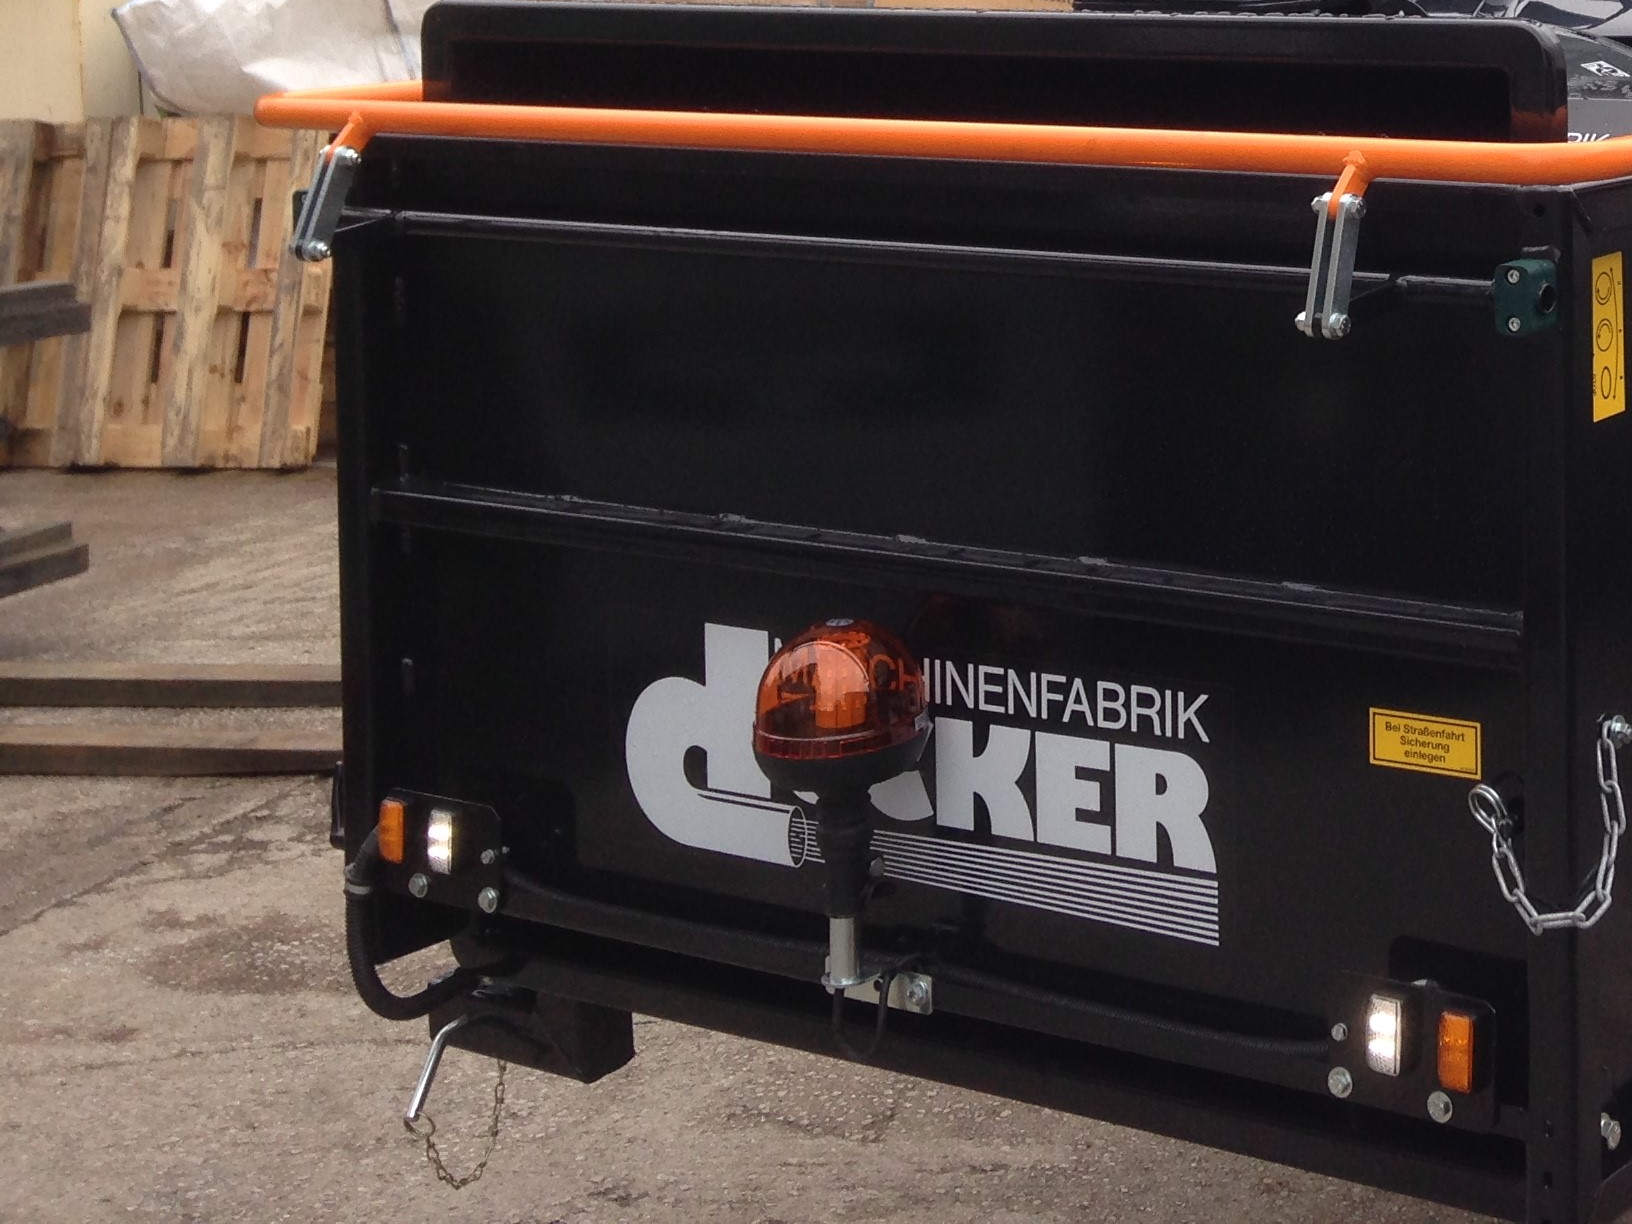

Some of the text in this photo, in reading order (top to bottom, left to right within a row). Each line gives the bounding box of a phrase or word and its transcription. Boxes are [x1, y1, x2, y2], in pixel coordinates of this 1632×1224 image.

[1384, 721, 1466, 743] Bei Straßenfahrt
[1399, 735, 1451, 754] Sicherung
[1403, 749, 1447, 764] einlegen
